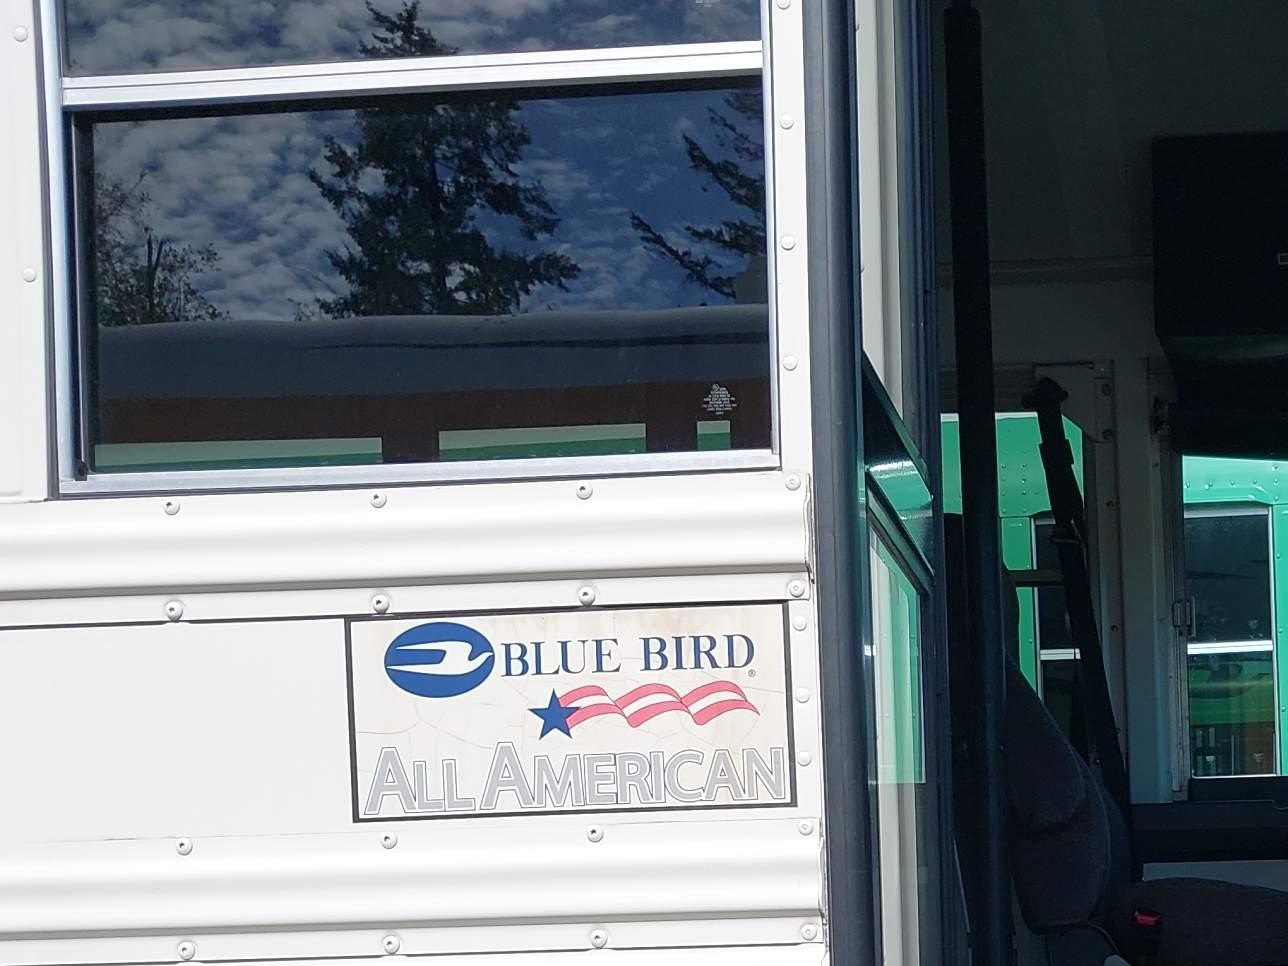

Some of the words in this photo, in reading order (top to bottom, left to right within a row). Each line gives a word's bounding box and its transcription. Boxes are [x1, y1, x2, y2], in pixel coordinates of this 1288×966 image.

[500, 637, 622, 678] BLUE
[363, 746, 476, 816] ALL
[479, 741, 785, 811] AMERICAN
